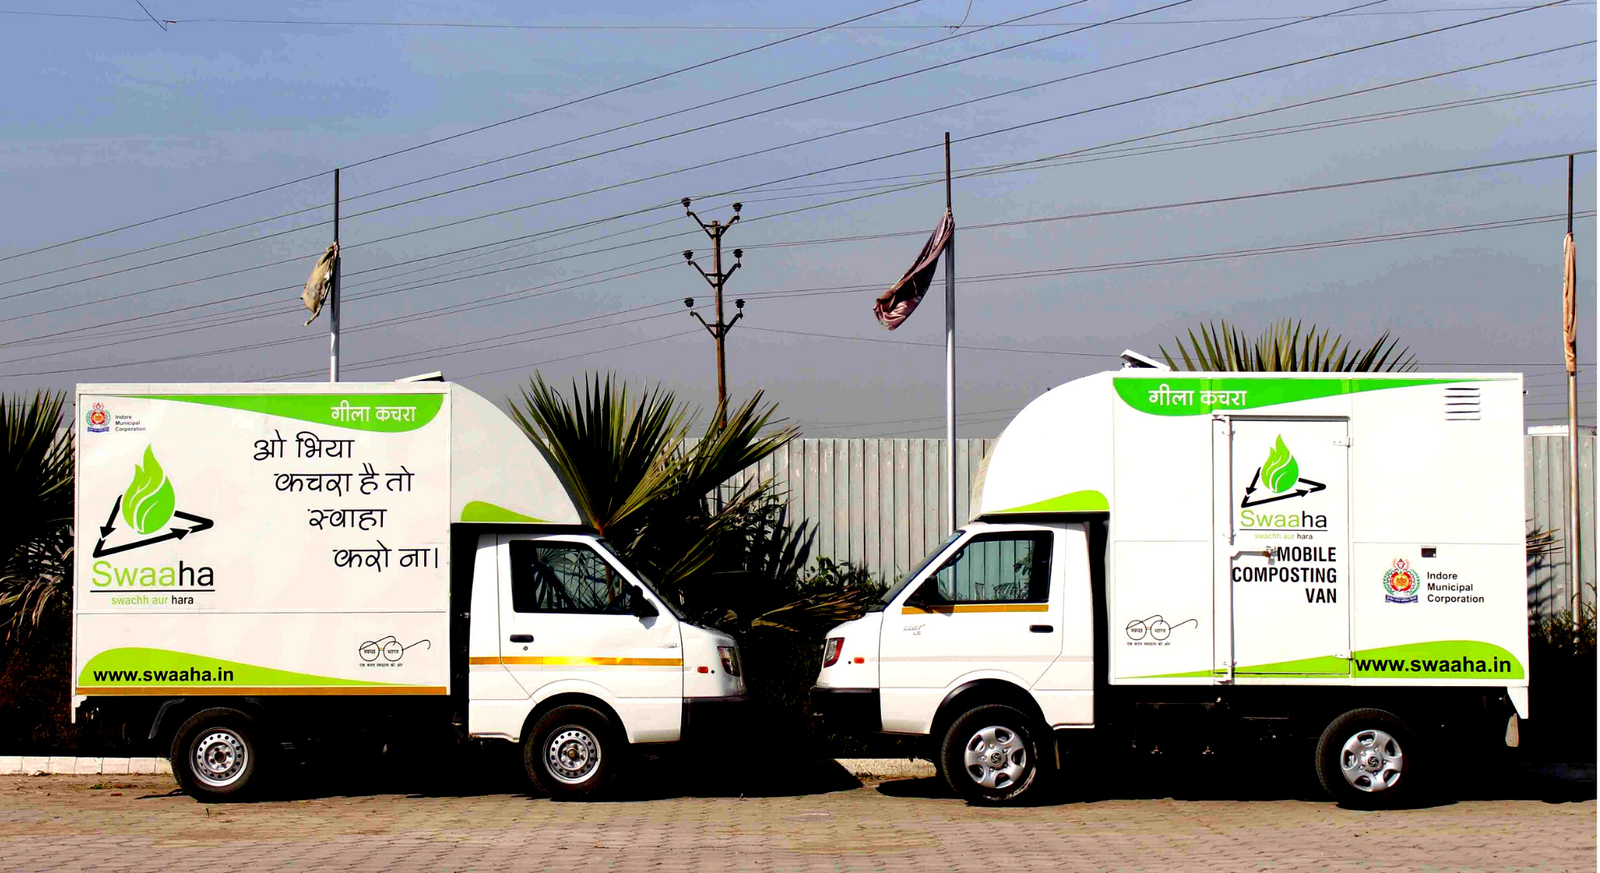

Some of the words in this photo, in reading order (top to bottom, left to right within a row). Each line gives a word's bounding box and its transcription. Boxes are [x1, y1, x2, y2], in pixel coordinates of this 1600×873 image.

[1148, 383, 1195, 406] गीला
[1199, 390, 1248, 406] कचरा
[330, 399, 371, 422] गीला
[375, 406, 417, 422] कचरा
[253, 429, 288, 461] ओ
[295, 431, 356, 459] भिया
[273, 473, 354, 497] कचरा
[358, 462, 380, 495] है
[384, 465, 415, 492] तो
[307, 508, 388, 531] स्वाहा
[1240, 509, 1328, 529] Swaaha
[1254, 532, 1282, 540] swachh
[332, 540, 393, 573] करो
[1276, 546, 1337, 562] MOBILE
[91, 560, 215, 588] Swaaha
[1231, 566, 1337, 584] COMPOSTING
[1426, 571, 1458, 581] Indore
[1305, 588, 1337, 604] VAN
[1426, 582, 1474, 593] Municipal
[111, 594, 150, 606] swachh
[151, 596, 169, 606] aur
[171, 594, 195, 606] hara
[1426, 593, 1486, 605] Corporation
[1354, 655, 1512, 674] www.swaaha.in
[93, 666, 235, 683] www.swaaha.in
